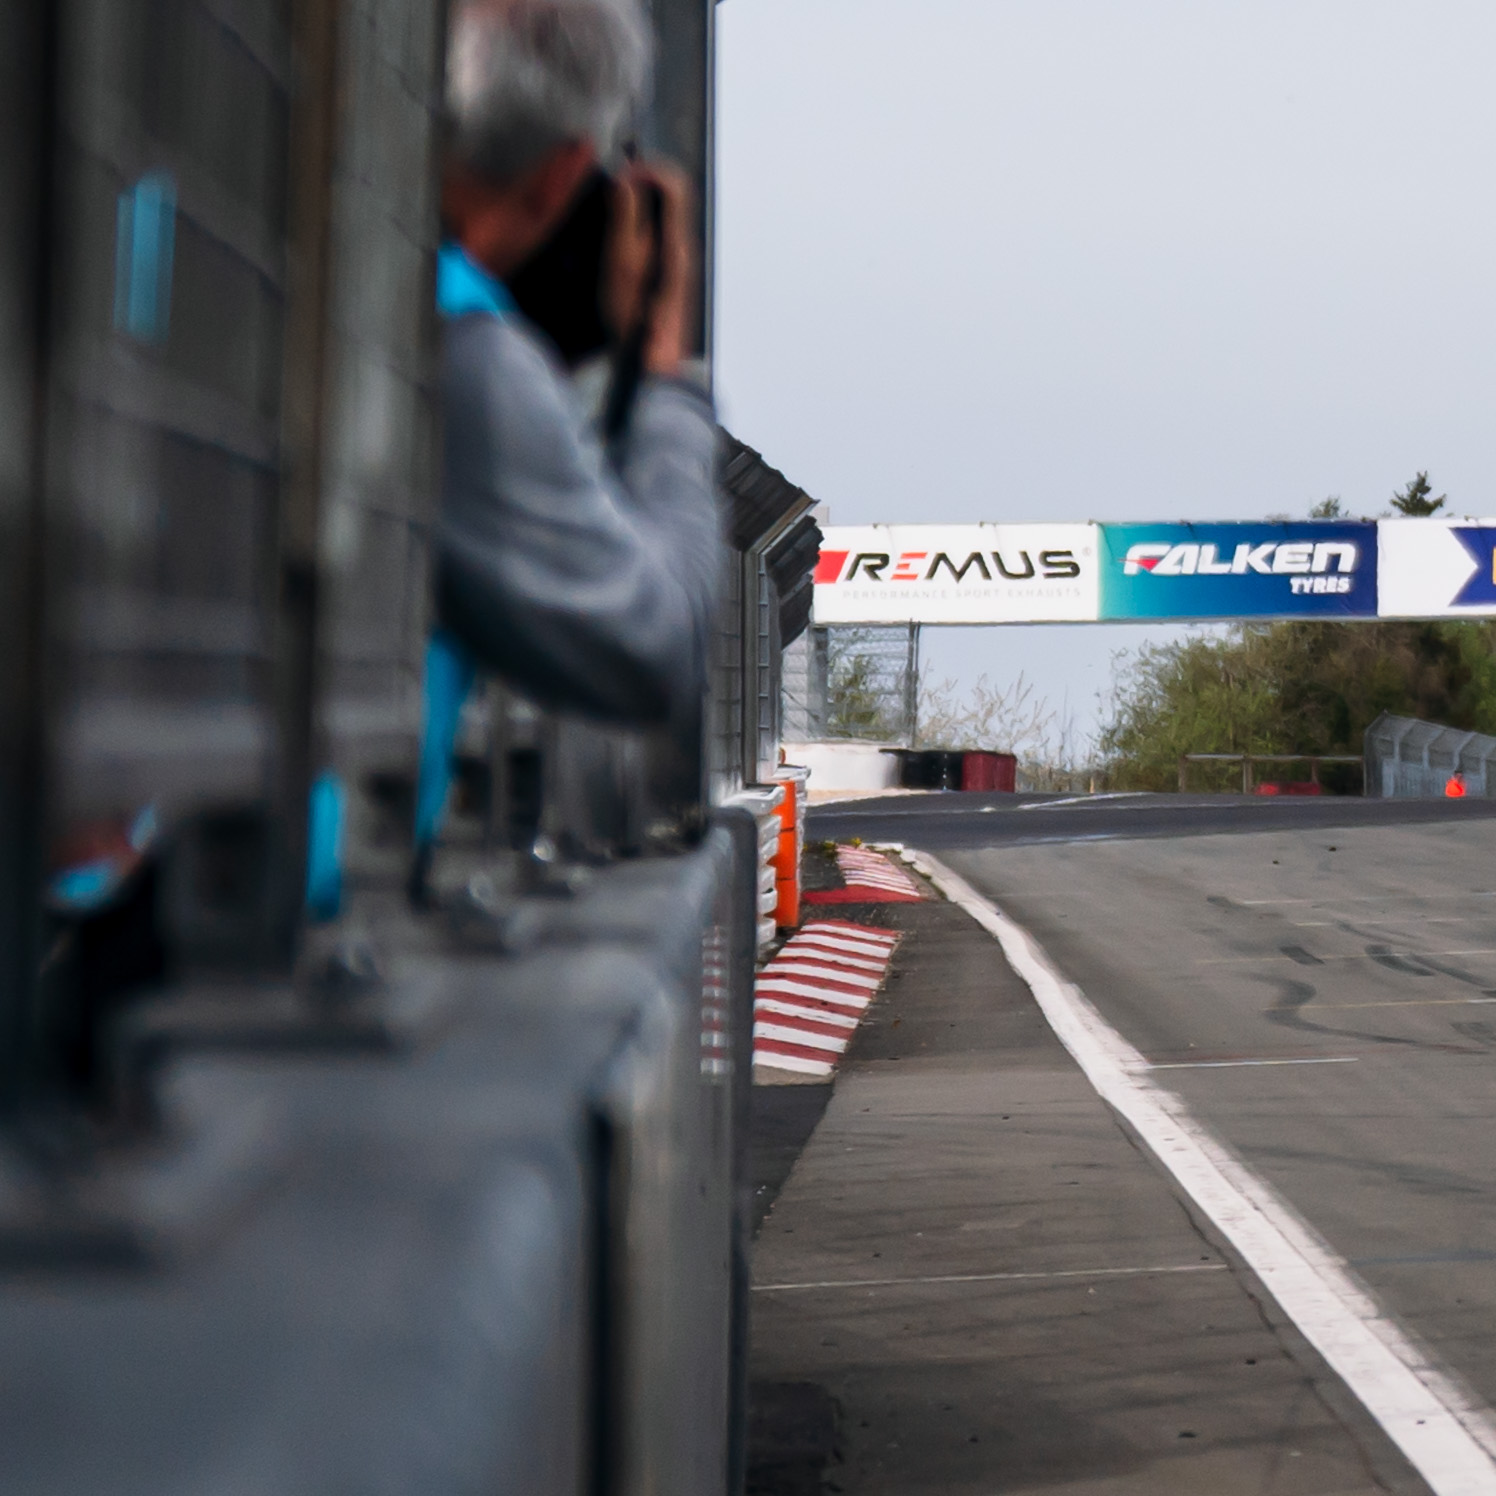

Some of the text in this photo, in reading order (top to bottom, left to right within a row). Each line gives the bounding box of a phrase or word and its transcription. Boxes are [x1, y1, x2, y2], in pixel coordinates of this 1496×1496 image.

[844, 550, 1081, 583] REMUS
[1122, 542, 1356, 575] FALKEN
[842, 586, 1081, 600] PERFORMANCE SPORT EXHAUSTS
[1290, 576, 1350, 594] TYRES
